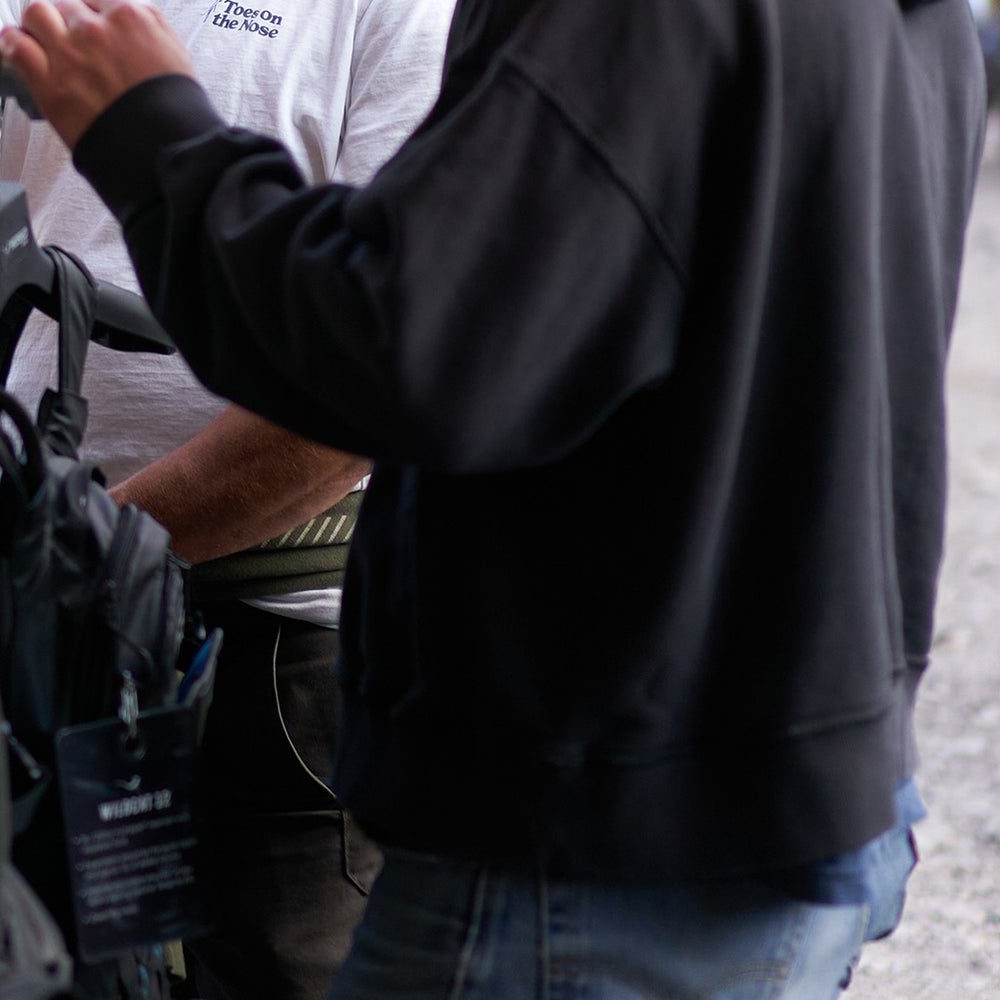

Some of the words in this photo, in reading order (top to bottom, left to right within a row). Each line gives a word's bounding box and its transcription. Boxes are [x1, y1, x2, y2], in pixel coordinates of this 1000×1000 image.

[212, 13, 239, 30] the
[238, 19, 279, 39] Nose
[224, 0, 260, 19] Toes
[260, 10, 283, 26] On
